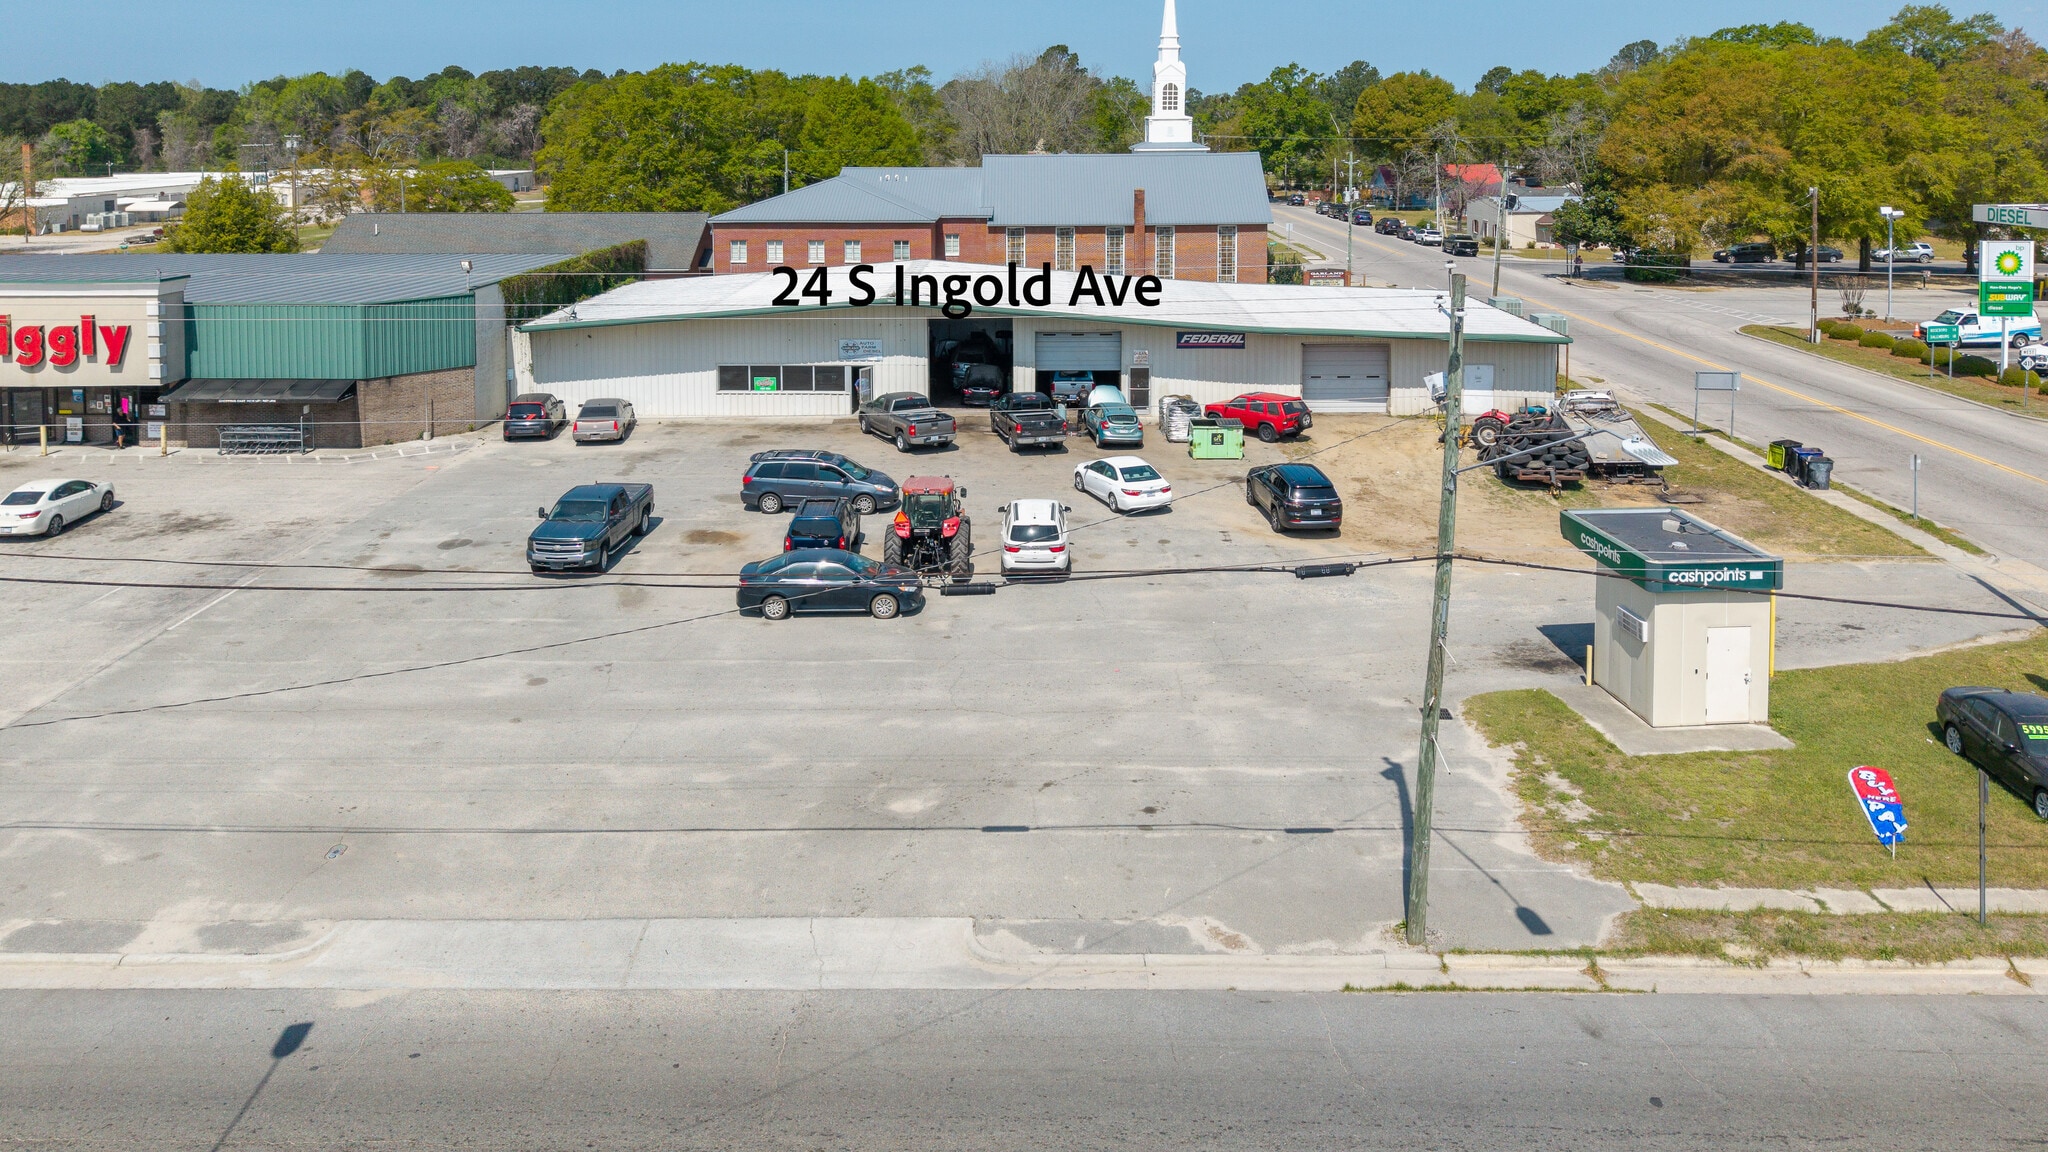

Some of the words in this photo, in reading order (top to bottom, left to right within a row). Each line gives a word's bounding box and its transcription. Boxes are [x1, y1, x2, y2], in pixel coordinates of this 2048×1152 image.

[1987, 207, 2032, 225] DIESEL
[1988, 293, 2027, 301] SUBWAY
[1180, 334, 1245, 344] FEDERAL
[1580, 532, 1621, 565] cashpoints
[1668, 566, 1747, 586] cashpoints
[2021, 724, 2048, 734] 5995
[1858, 769, 1894, 796] BUY
[1866, 794, 1897, 803] HERE
[1866, 799, 1908, 833] PAY
